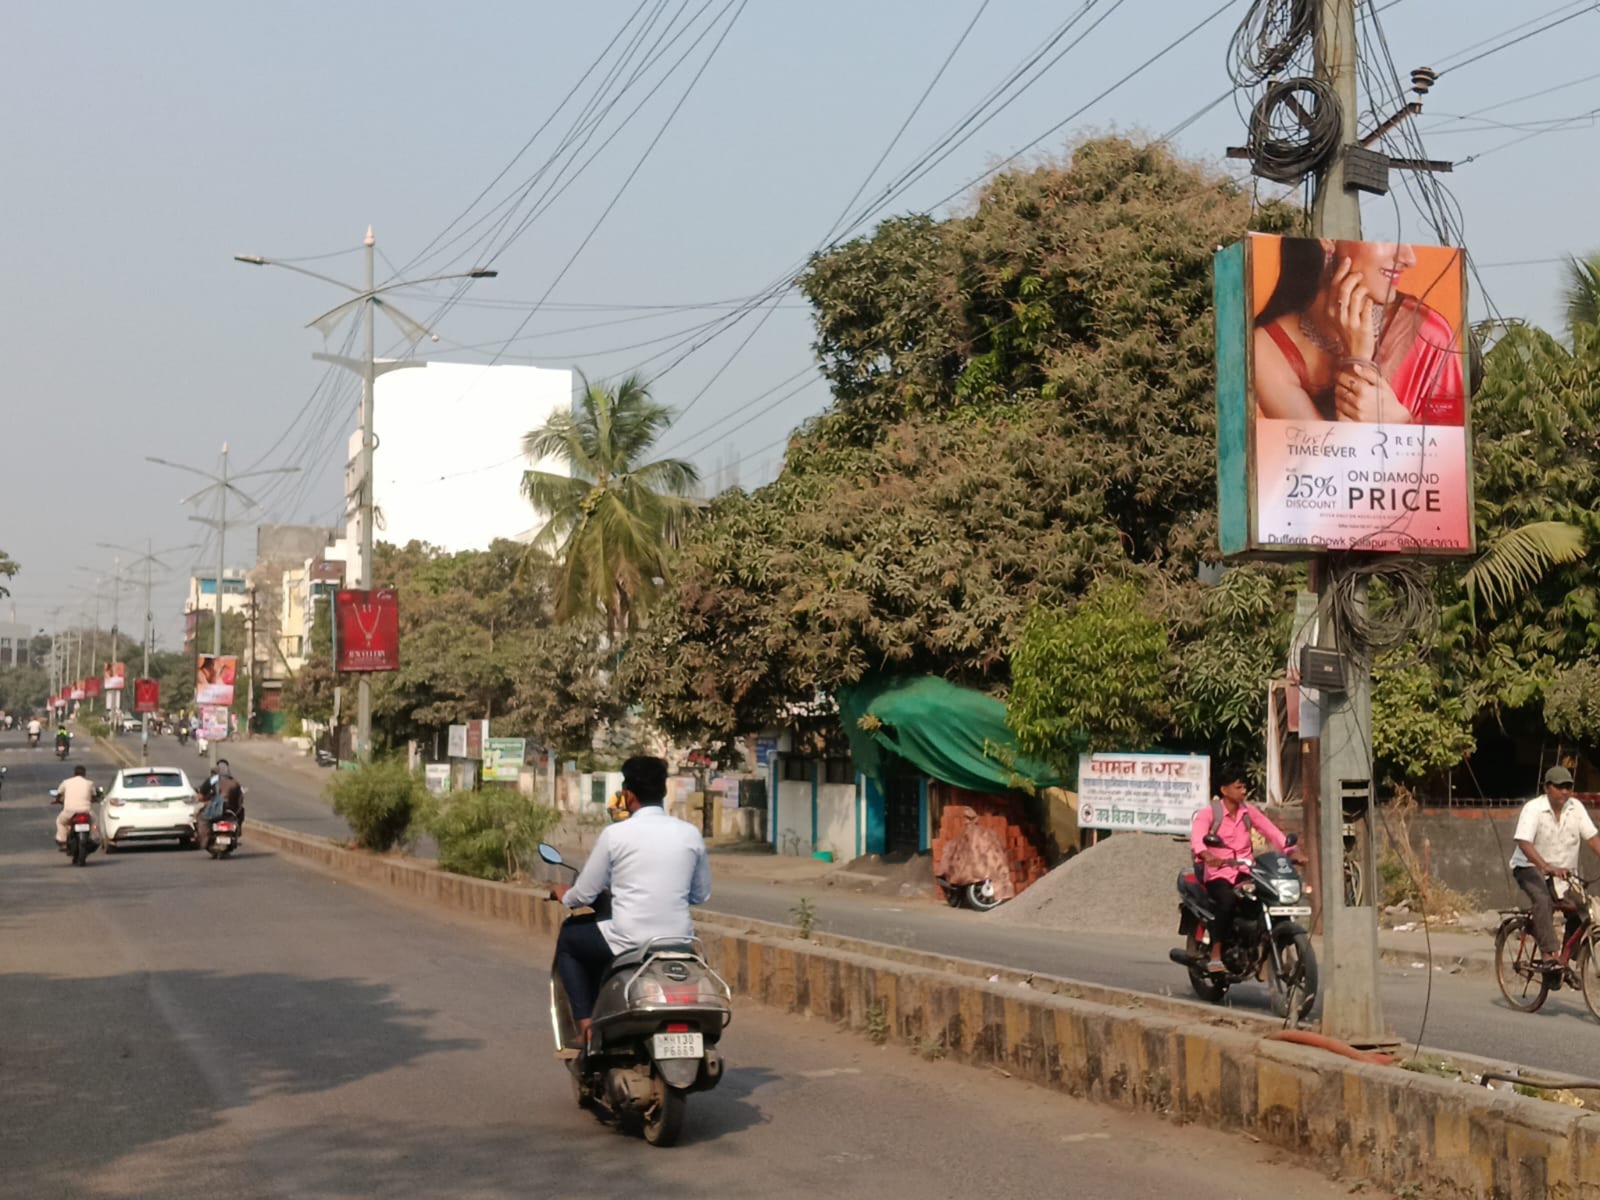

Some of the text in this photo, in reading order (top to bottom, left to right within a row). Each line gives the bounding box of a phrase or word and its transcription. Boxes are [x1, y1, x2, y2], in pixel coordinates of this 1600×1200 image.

[1395, 436, 1438, 447] REVA
[1287, 444, 1357, 458] TIME EVER
[1347, 470, 1440, 485] ON DIAMOND
[1286, 473, 1337, 498] 25%
[1286, 499, 1336, 510] DISCOUNT
[1348, 487, 1441, 512] PRICE
[1310, 535, 1345, 546] Chowk
[1141, 761, 1187, 776] नगर
